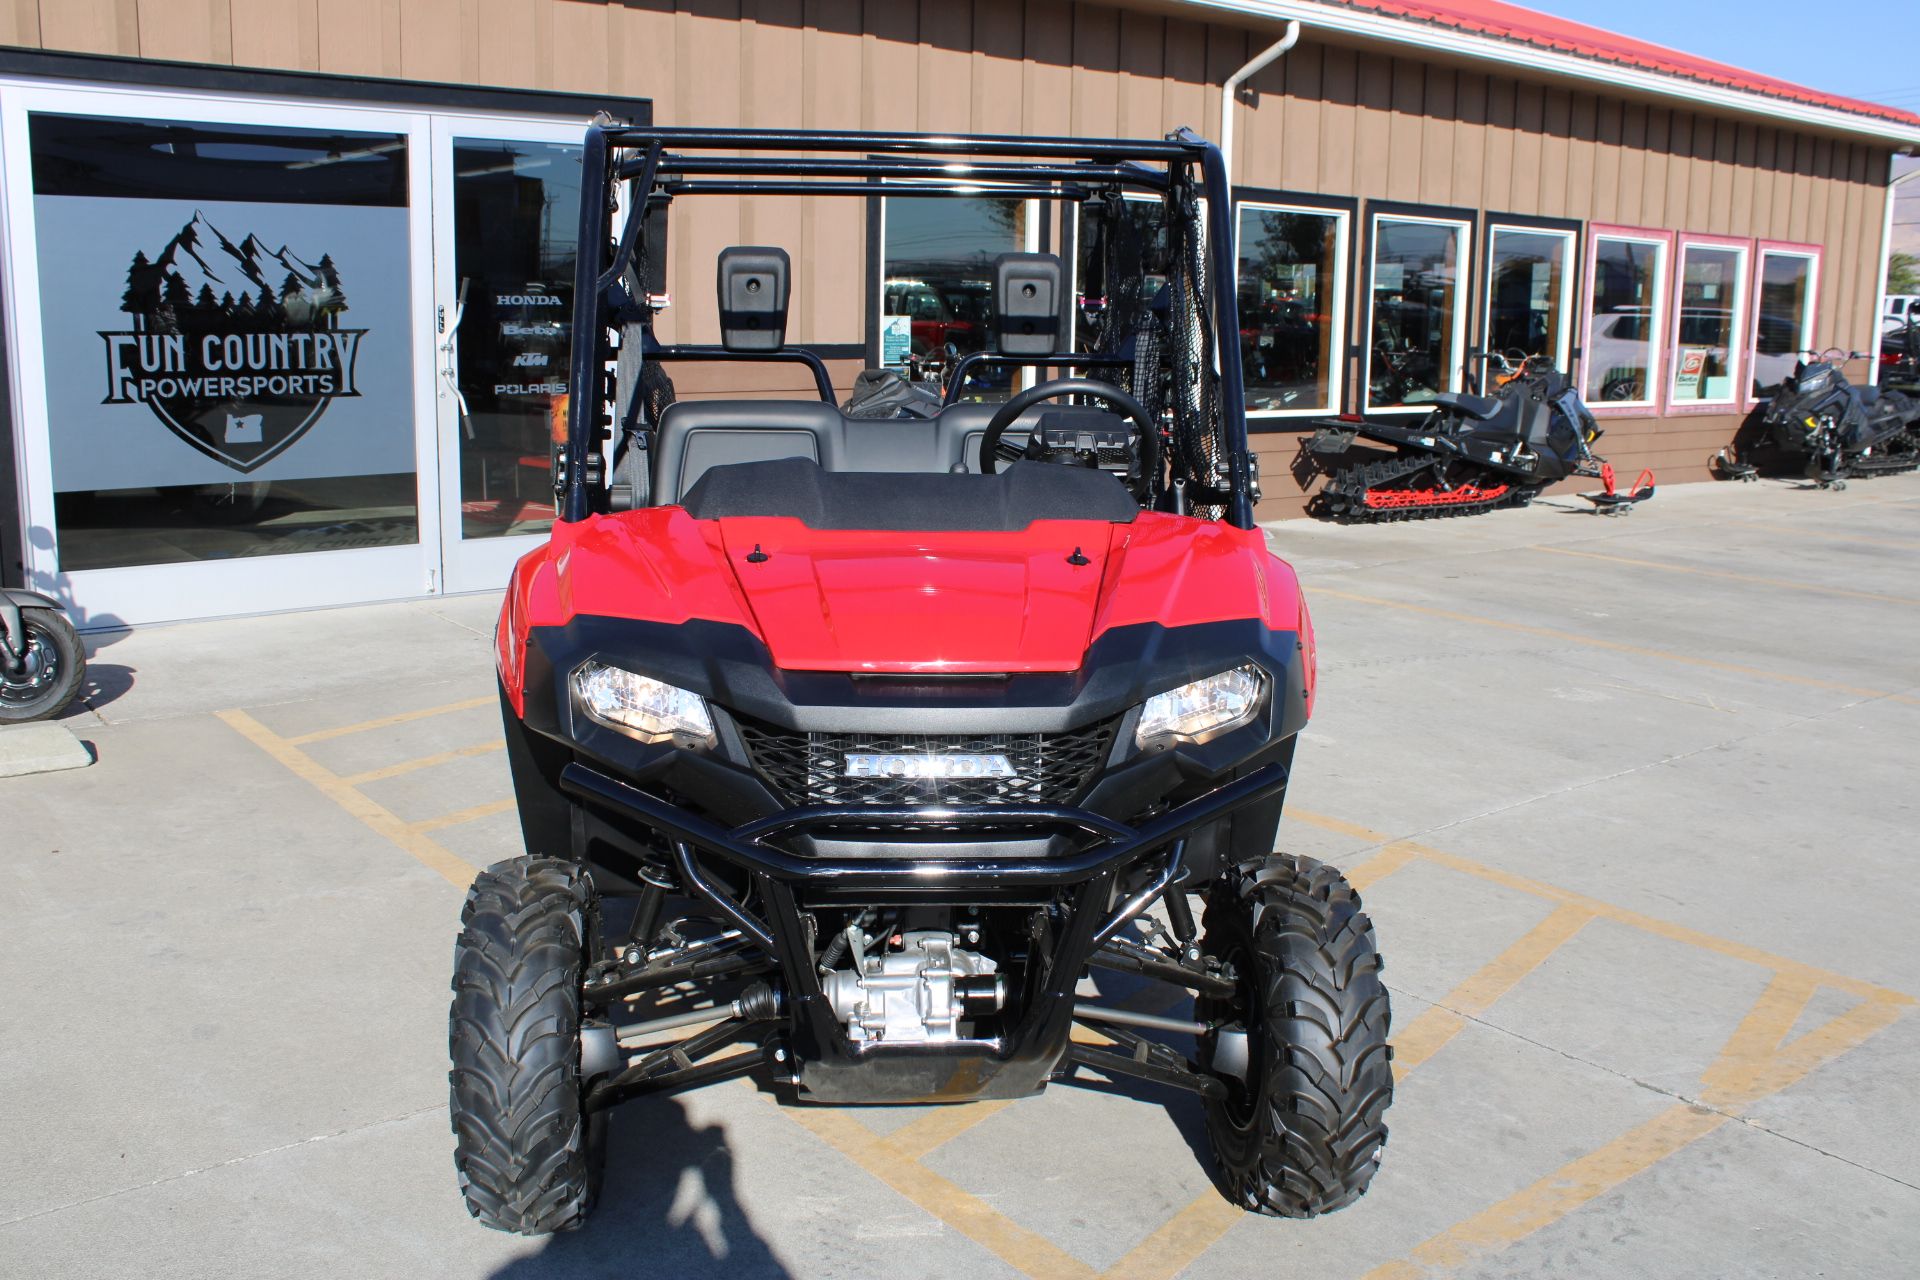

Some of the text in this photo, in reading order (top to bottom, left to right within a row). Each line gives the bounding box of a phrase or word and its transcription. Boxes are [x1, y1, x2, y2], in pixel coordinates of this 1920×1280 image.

[496, 295, 563, 305] HONDA
[503, 325, 558, 335] Beta
[513, 352, 549, 366] KTM
[106, 332, 360, 400] FUN COUNTRY
[141, 374, 334, 399] POWERSPORTS
[494, 383, 567, 395] POLARIS
